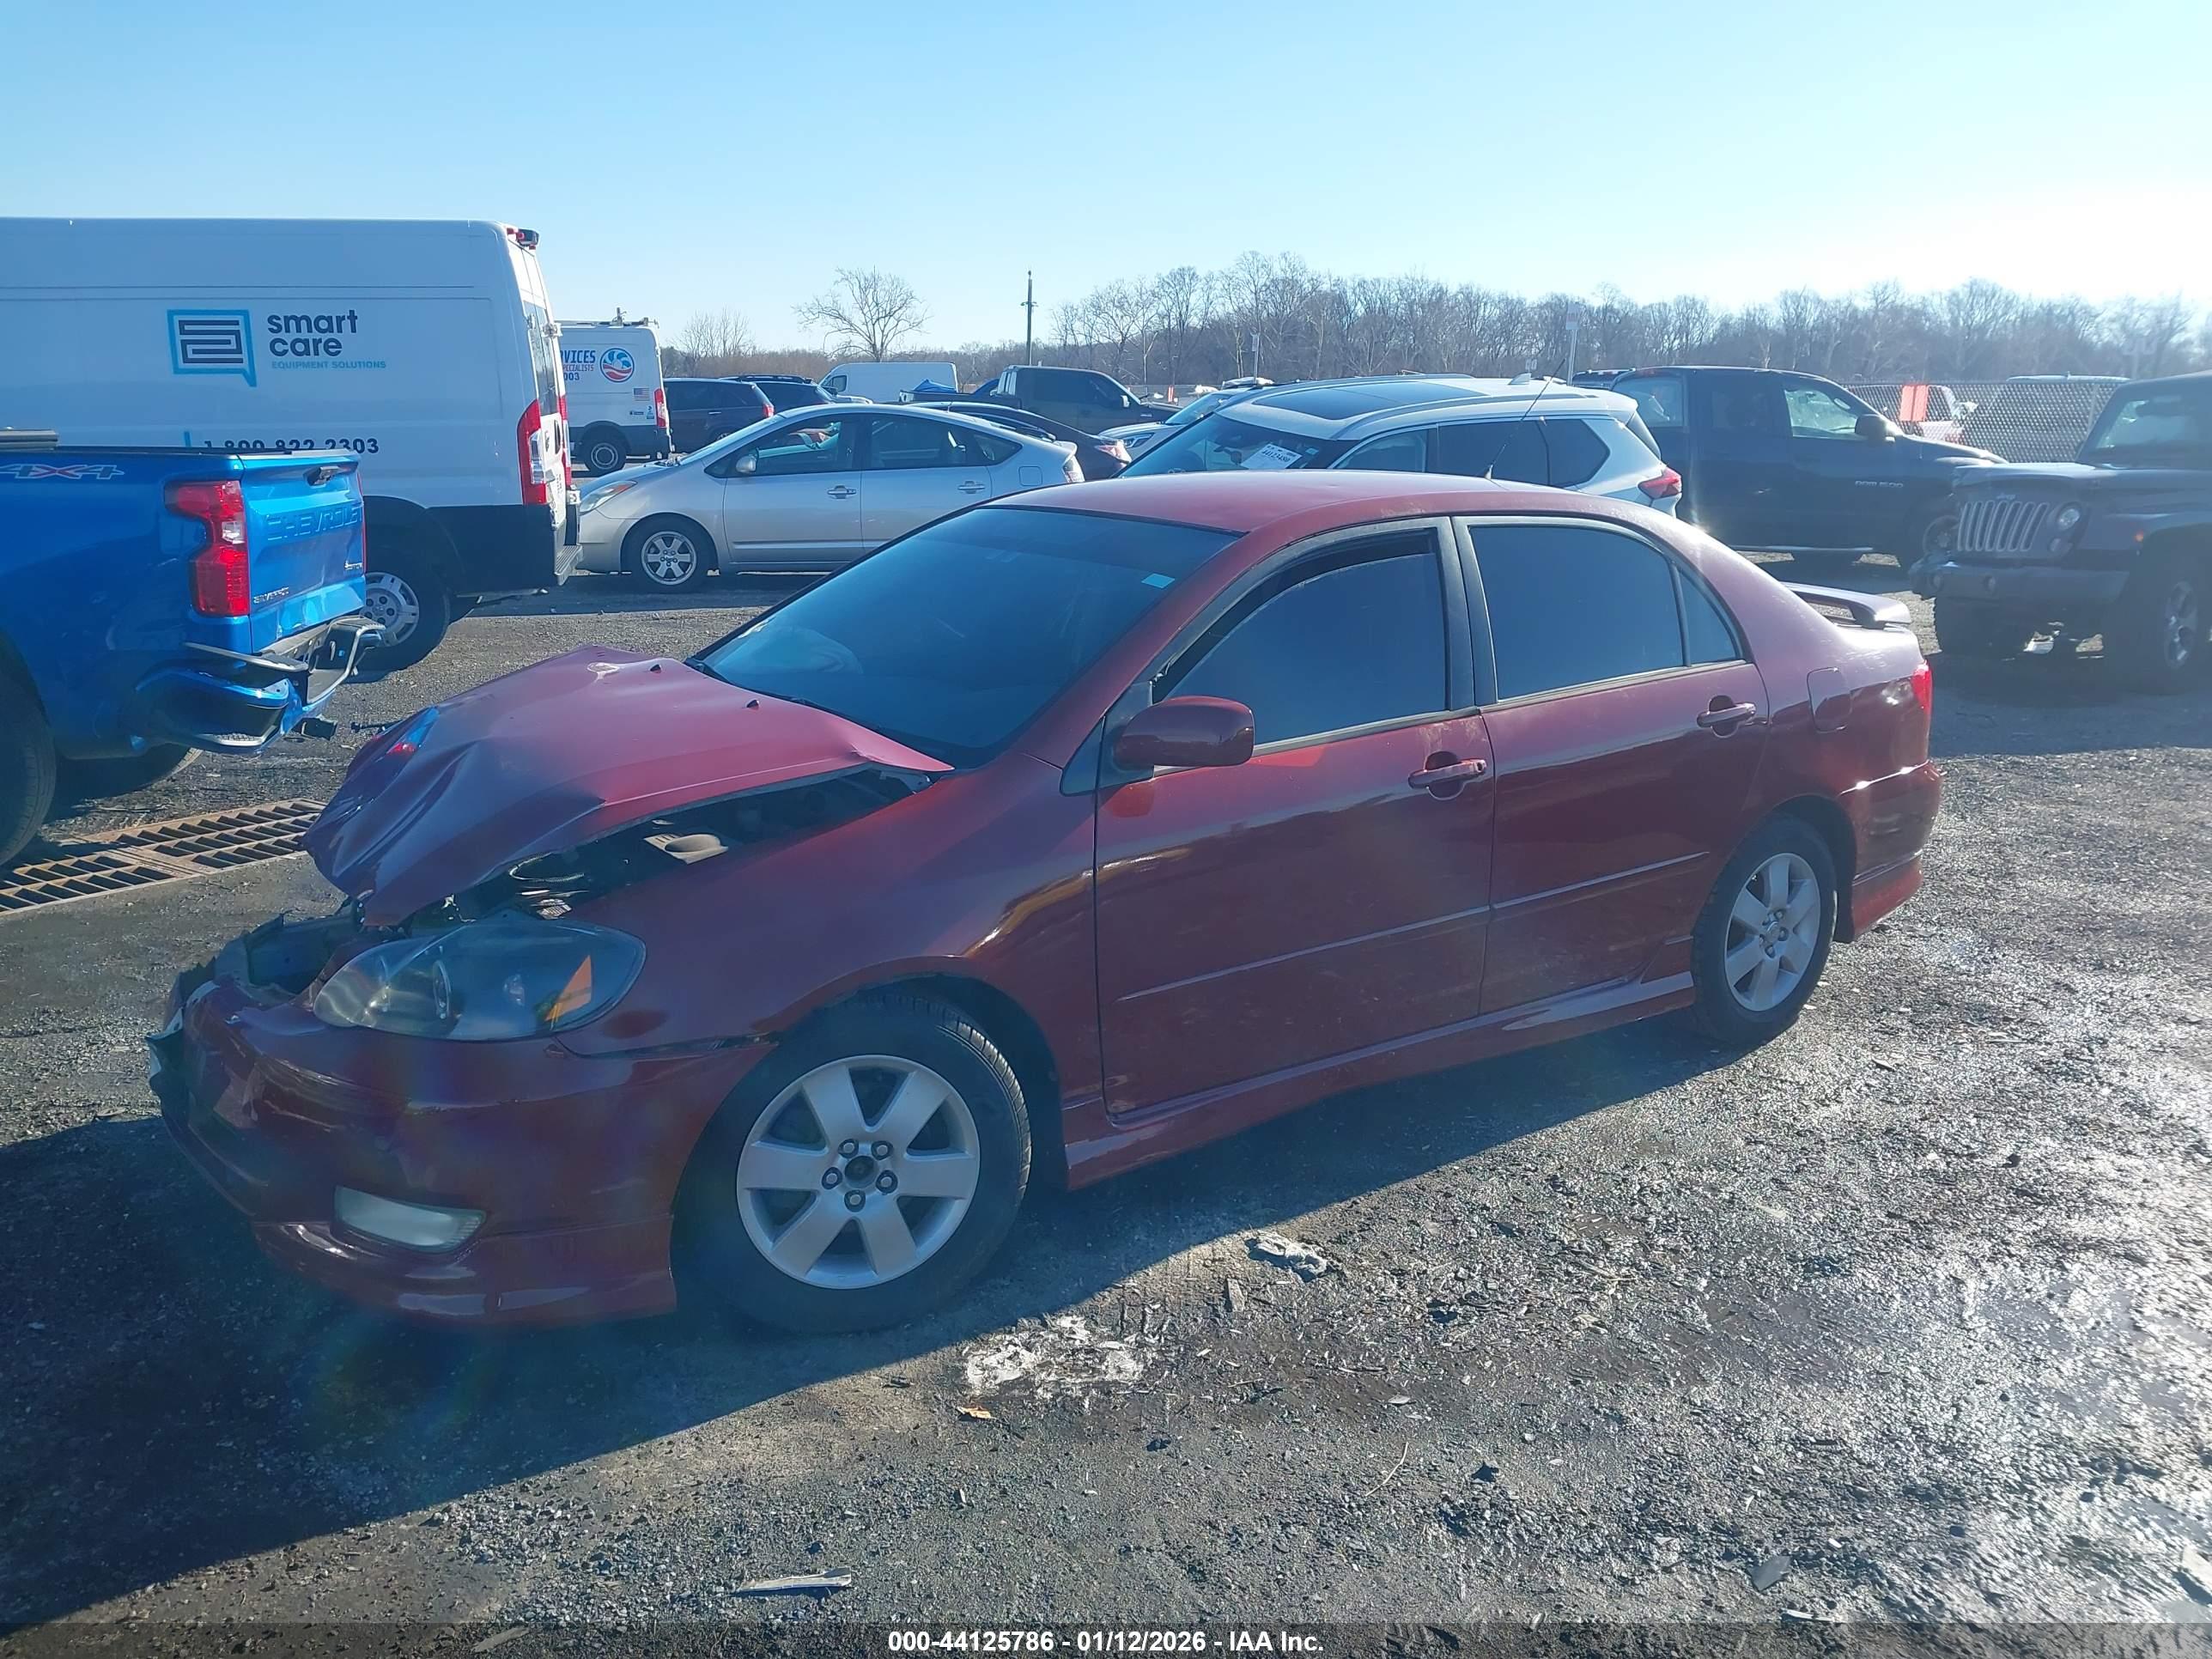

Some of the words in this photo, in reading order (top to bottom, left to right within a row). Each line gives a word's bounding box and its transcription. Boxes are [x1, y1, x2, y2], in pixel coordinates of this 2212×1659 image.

[267, 309, 358, 334] smart
[269, 337, 343, 357] care
[271, 361, 328, 370] EQUIPMENT
[331, 360, 386, 369] SOLUTIONS
[325, 438, 380, 454] 2303
